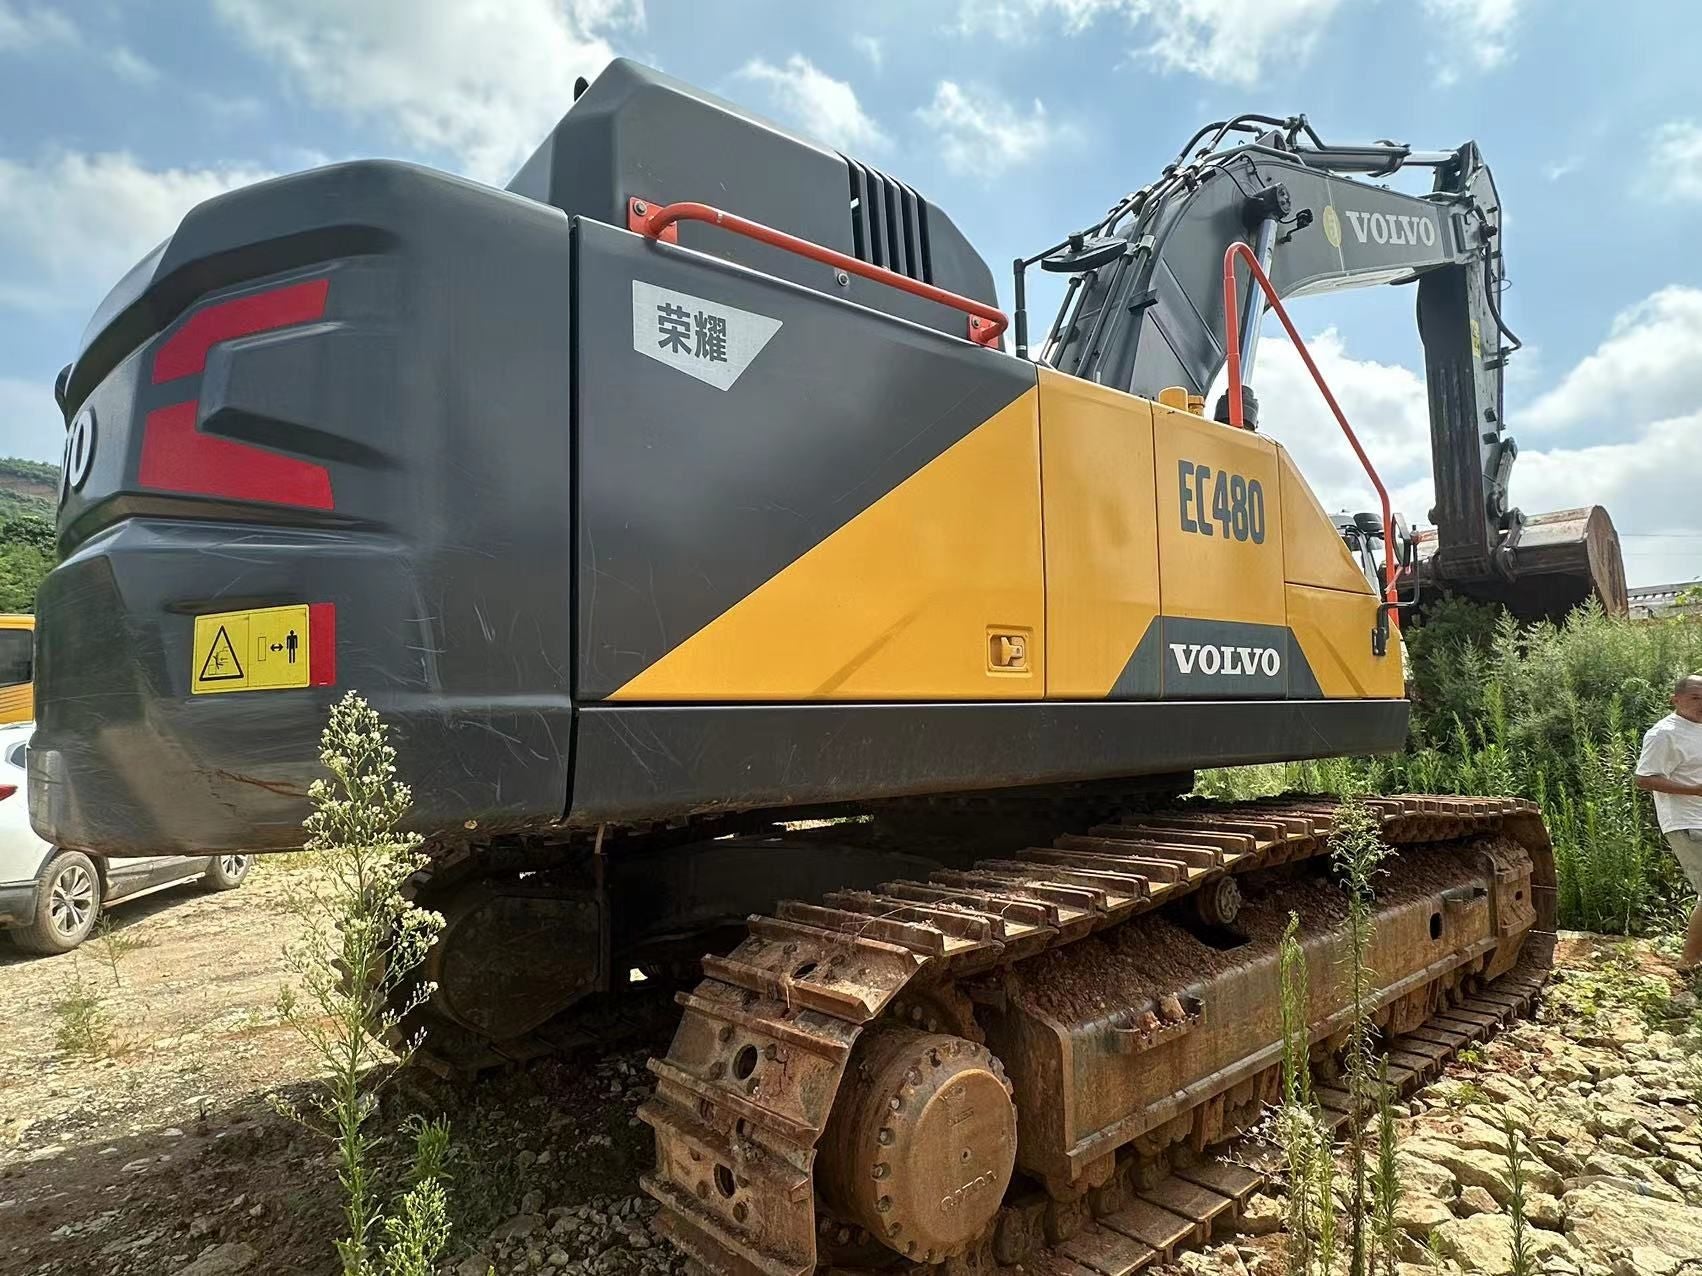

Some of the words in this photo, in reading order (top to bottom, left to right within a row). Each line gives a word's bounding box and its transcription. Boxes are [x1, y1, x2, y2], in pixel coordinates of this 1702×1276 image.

[1345, 210, 1435, 247] VOLVO
[656, 302, 728, 363] 荣耀
[1177, 459, 1265, 545] EC480
[1169, 642, 1281, 677] VOLVO
